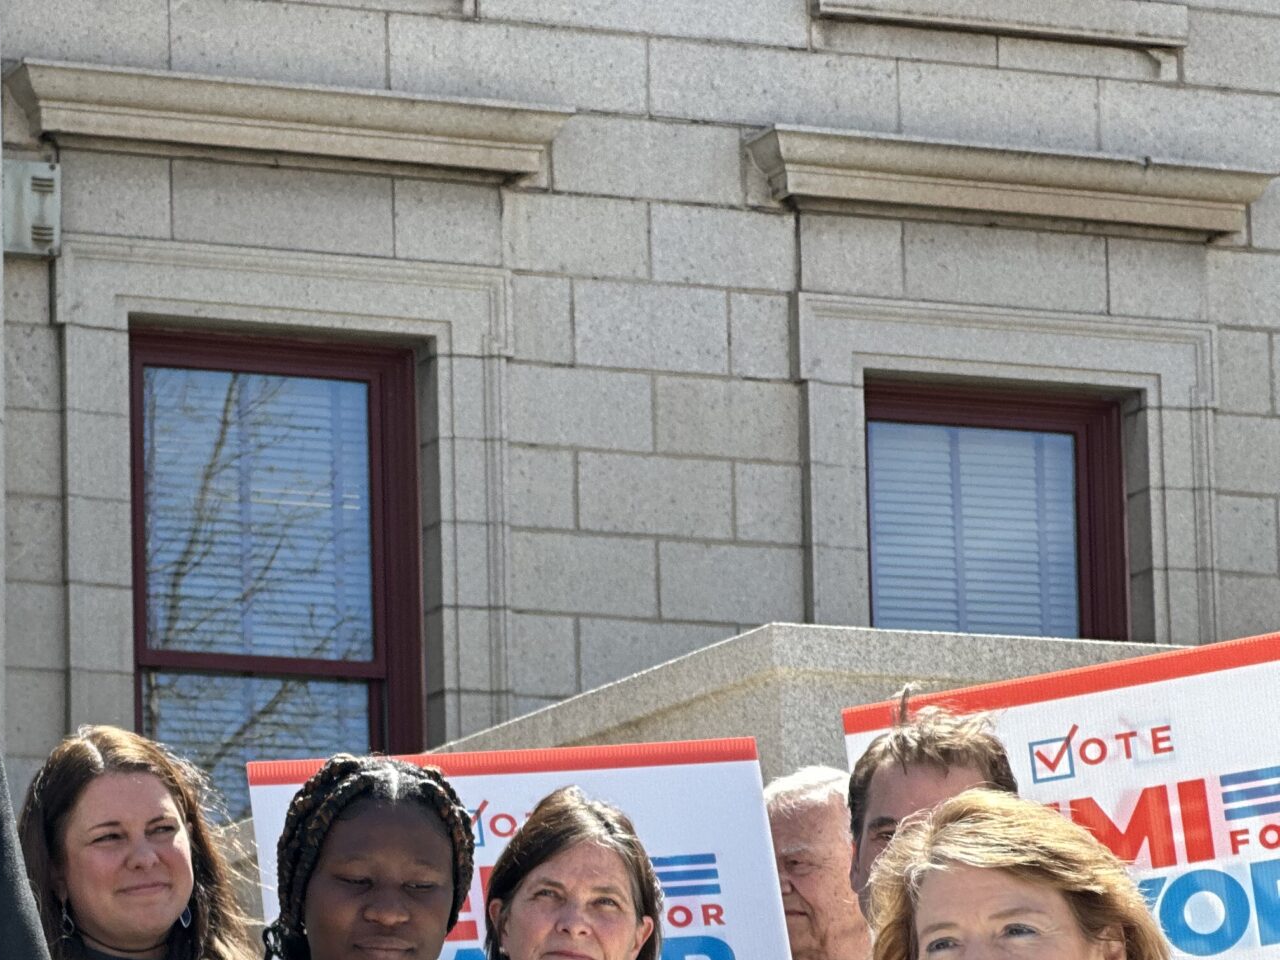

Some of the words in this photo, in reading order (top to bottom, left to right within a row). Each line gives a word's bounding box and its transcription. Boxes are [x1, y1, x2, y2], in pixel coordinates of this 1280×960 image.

[1044, 778, 1216, 870] MI
[1229, 823, 1280, 855] FO
[667, 903, 727, 929] OR
